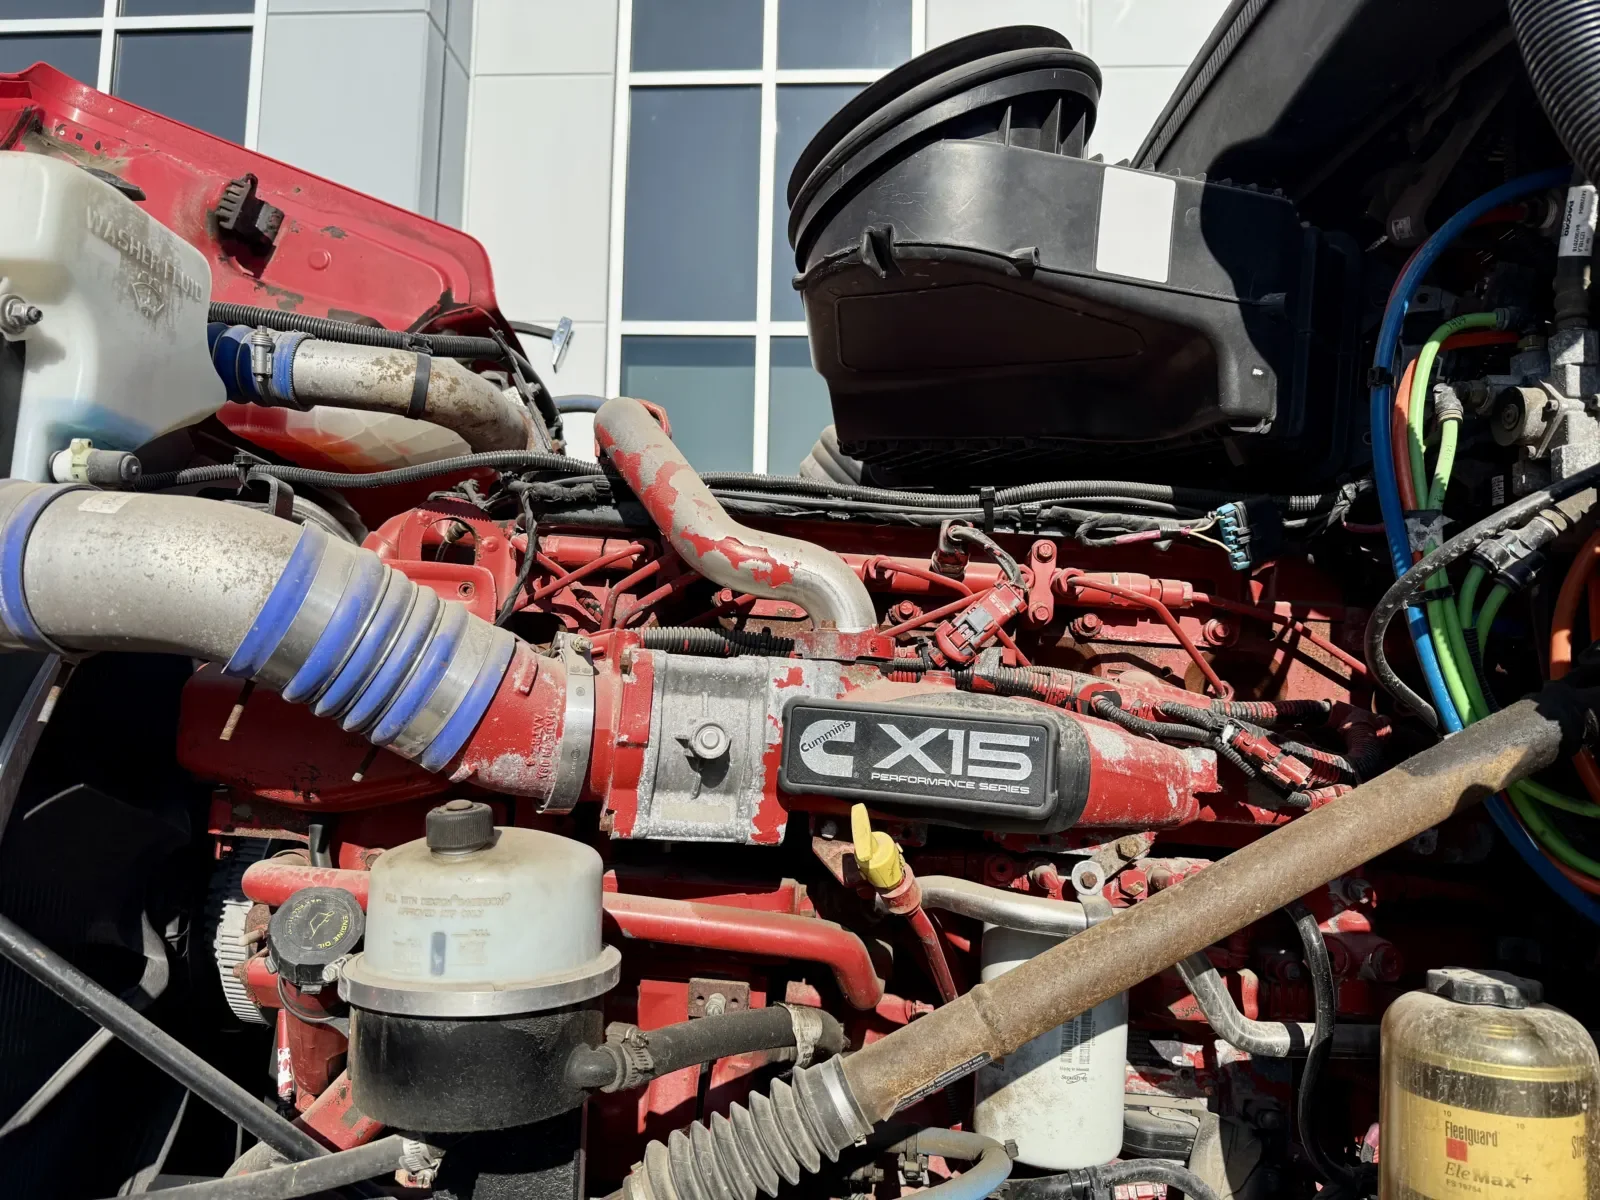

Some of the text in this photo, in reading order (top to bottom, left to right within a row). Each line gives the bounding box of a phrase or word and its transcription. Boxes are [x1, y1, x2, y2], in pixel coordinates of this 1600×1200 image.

[86, 205, 203, 302] WASHER FLUID
[872, 723, 1033, 782] X15
[871, 772, 1030, 796] PERFORMANCE SERIES
[317, 940, 332, 950] OIL
[1443, 1110, 1452, 1118] 10
[1445, 1120, 1498, 1148] Fleetguard
